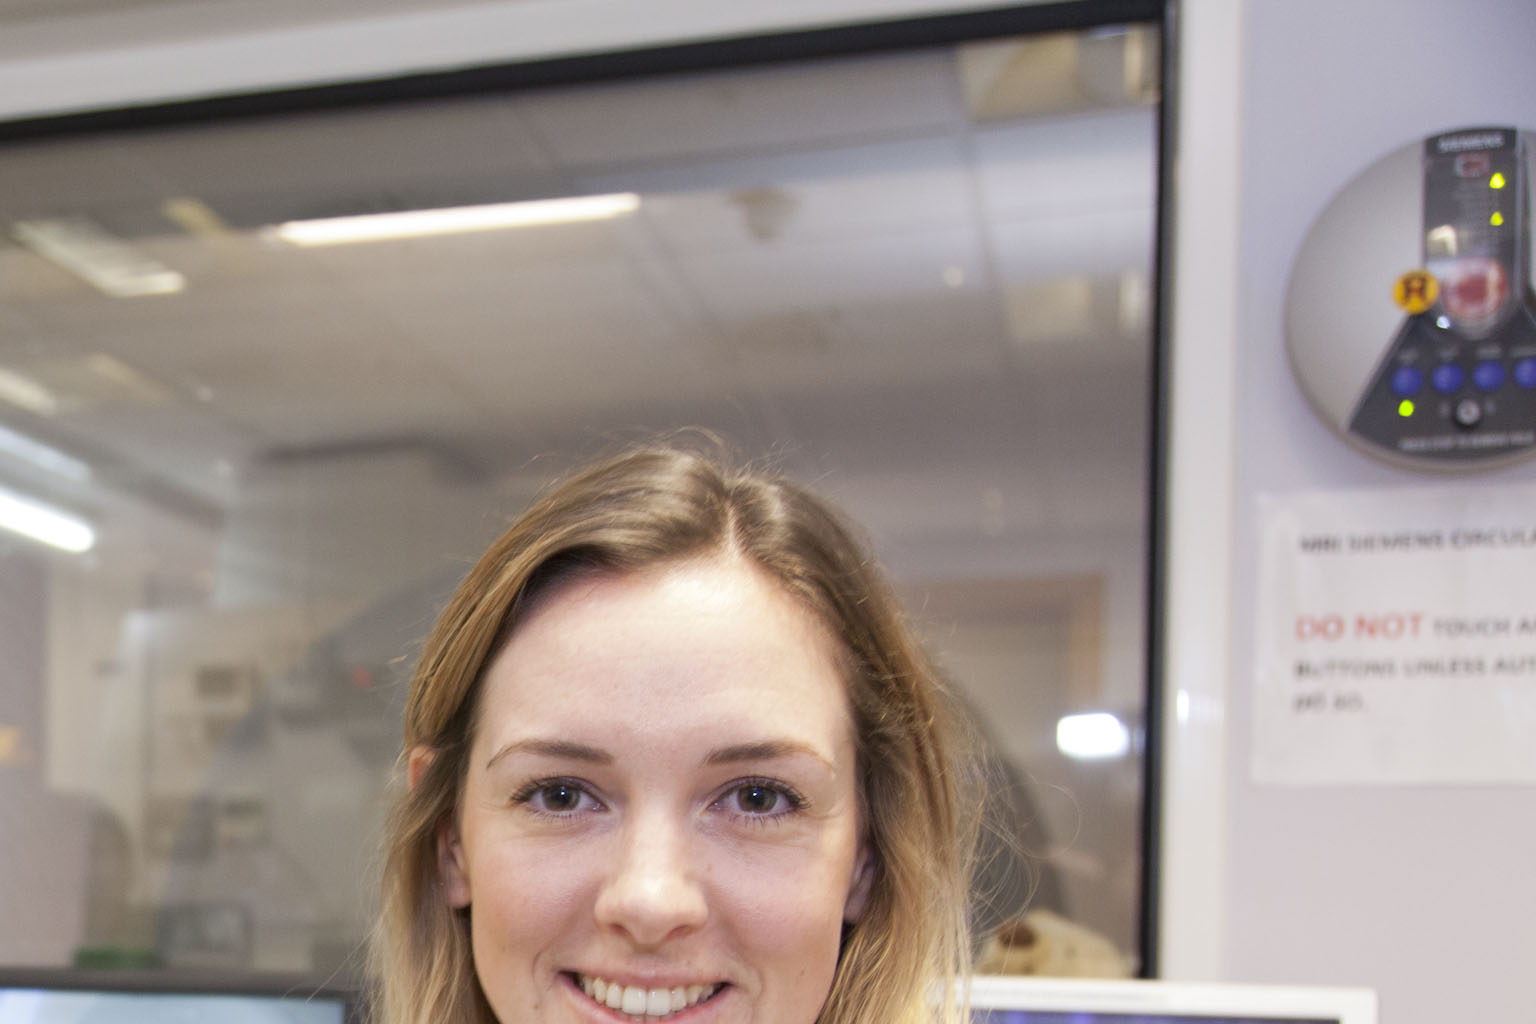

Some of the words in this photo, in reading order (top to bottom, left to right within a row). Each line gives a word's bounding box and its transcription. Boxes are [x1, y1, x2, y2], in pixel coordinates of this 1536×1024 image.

[1349, 533, 1443, 551] SIEMENS
[1295, 613, 1345, 641] DO
[1353, 610, 1423, 640] NOT
[1433, 616, 1511, 638] TOUCH
[1295, 659, 1395, 679] BUTTONS
[1404, 657, 1484, 677] UNLESS
